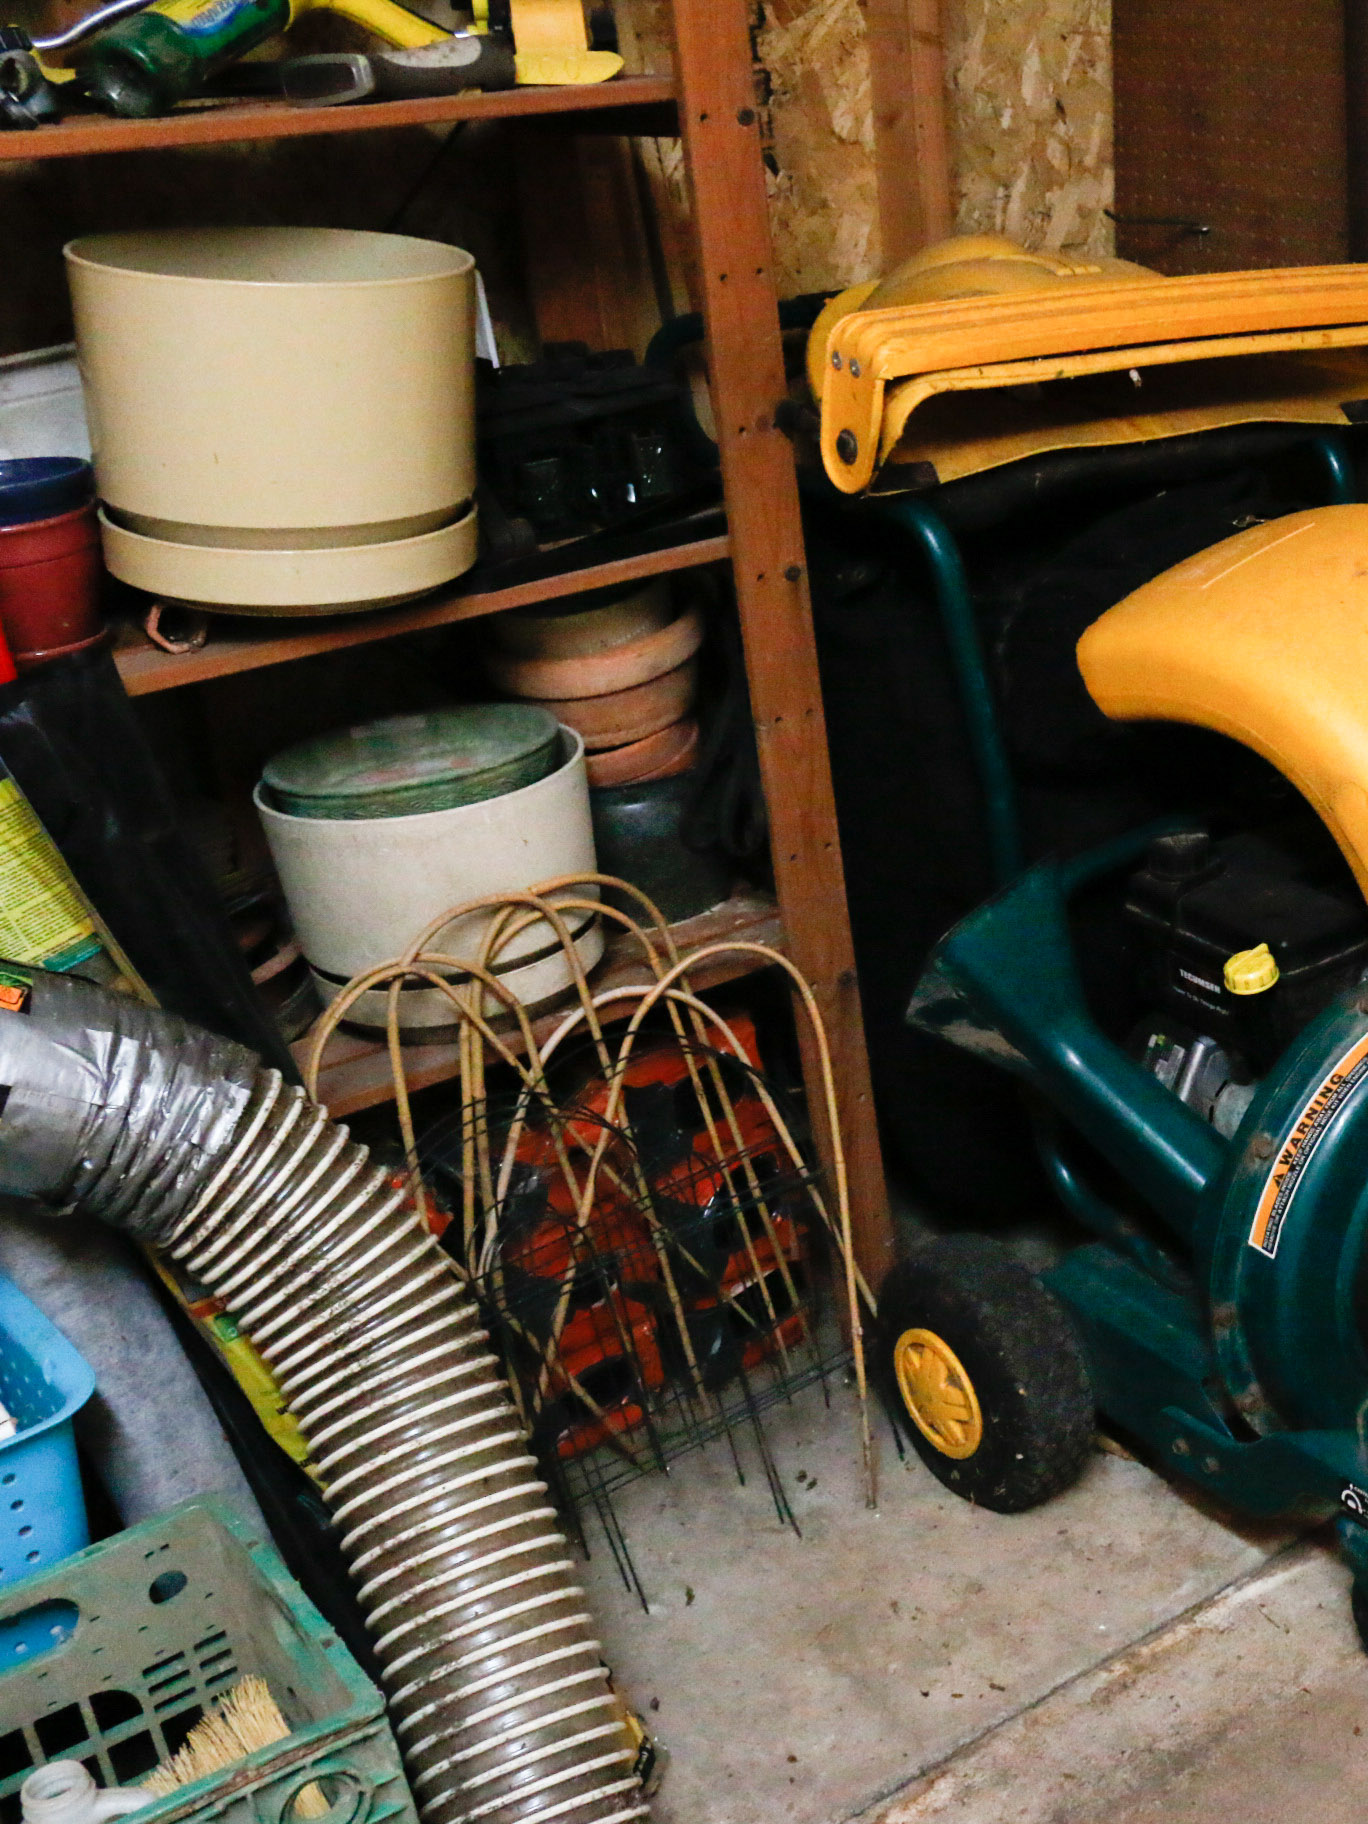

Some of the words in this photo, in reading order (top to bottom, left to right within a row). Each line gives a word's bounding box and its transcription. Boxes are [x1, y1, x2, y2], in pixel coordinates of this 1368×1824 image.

[1277, 1189, 1289, 1213] ATTACH
[1287, 1165, 1300, 1188] NOZZLE
[1304, 1125, 1322, 1154] OPTIONAL
[1321, 1109, 1332, 1125] HOSE
[1338, 1082, 1352, 1099] WHEN
[1278, 1073, 1344, 1165] WARNING
[1302, 1126, 1315, 1147] HANDS
[1314, 1109, 1326, 1126] AWAY
[1325, 1092, 1338, 1109] FROM
[1337, 1082, 1346, 1092] ALL
